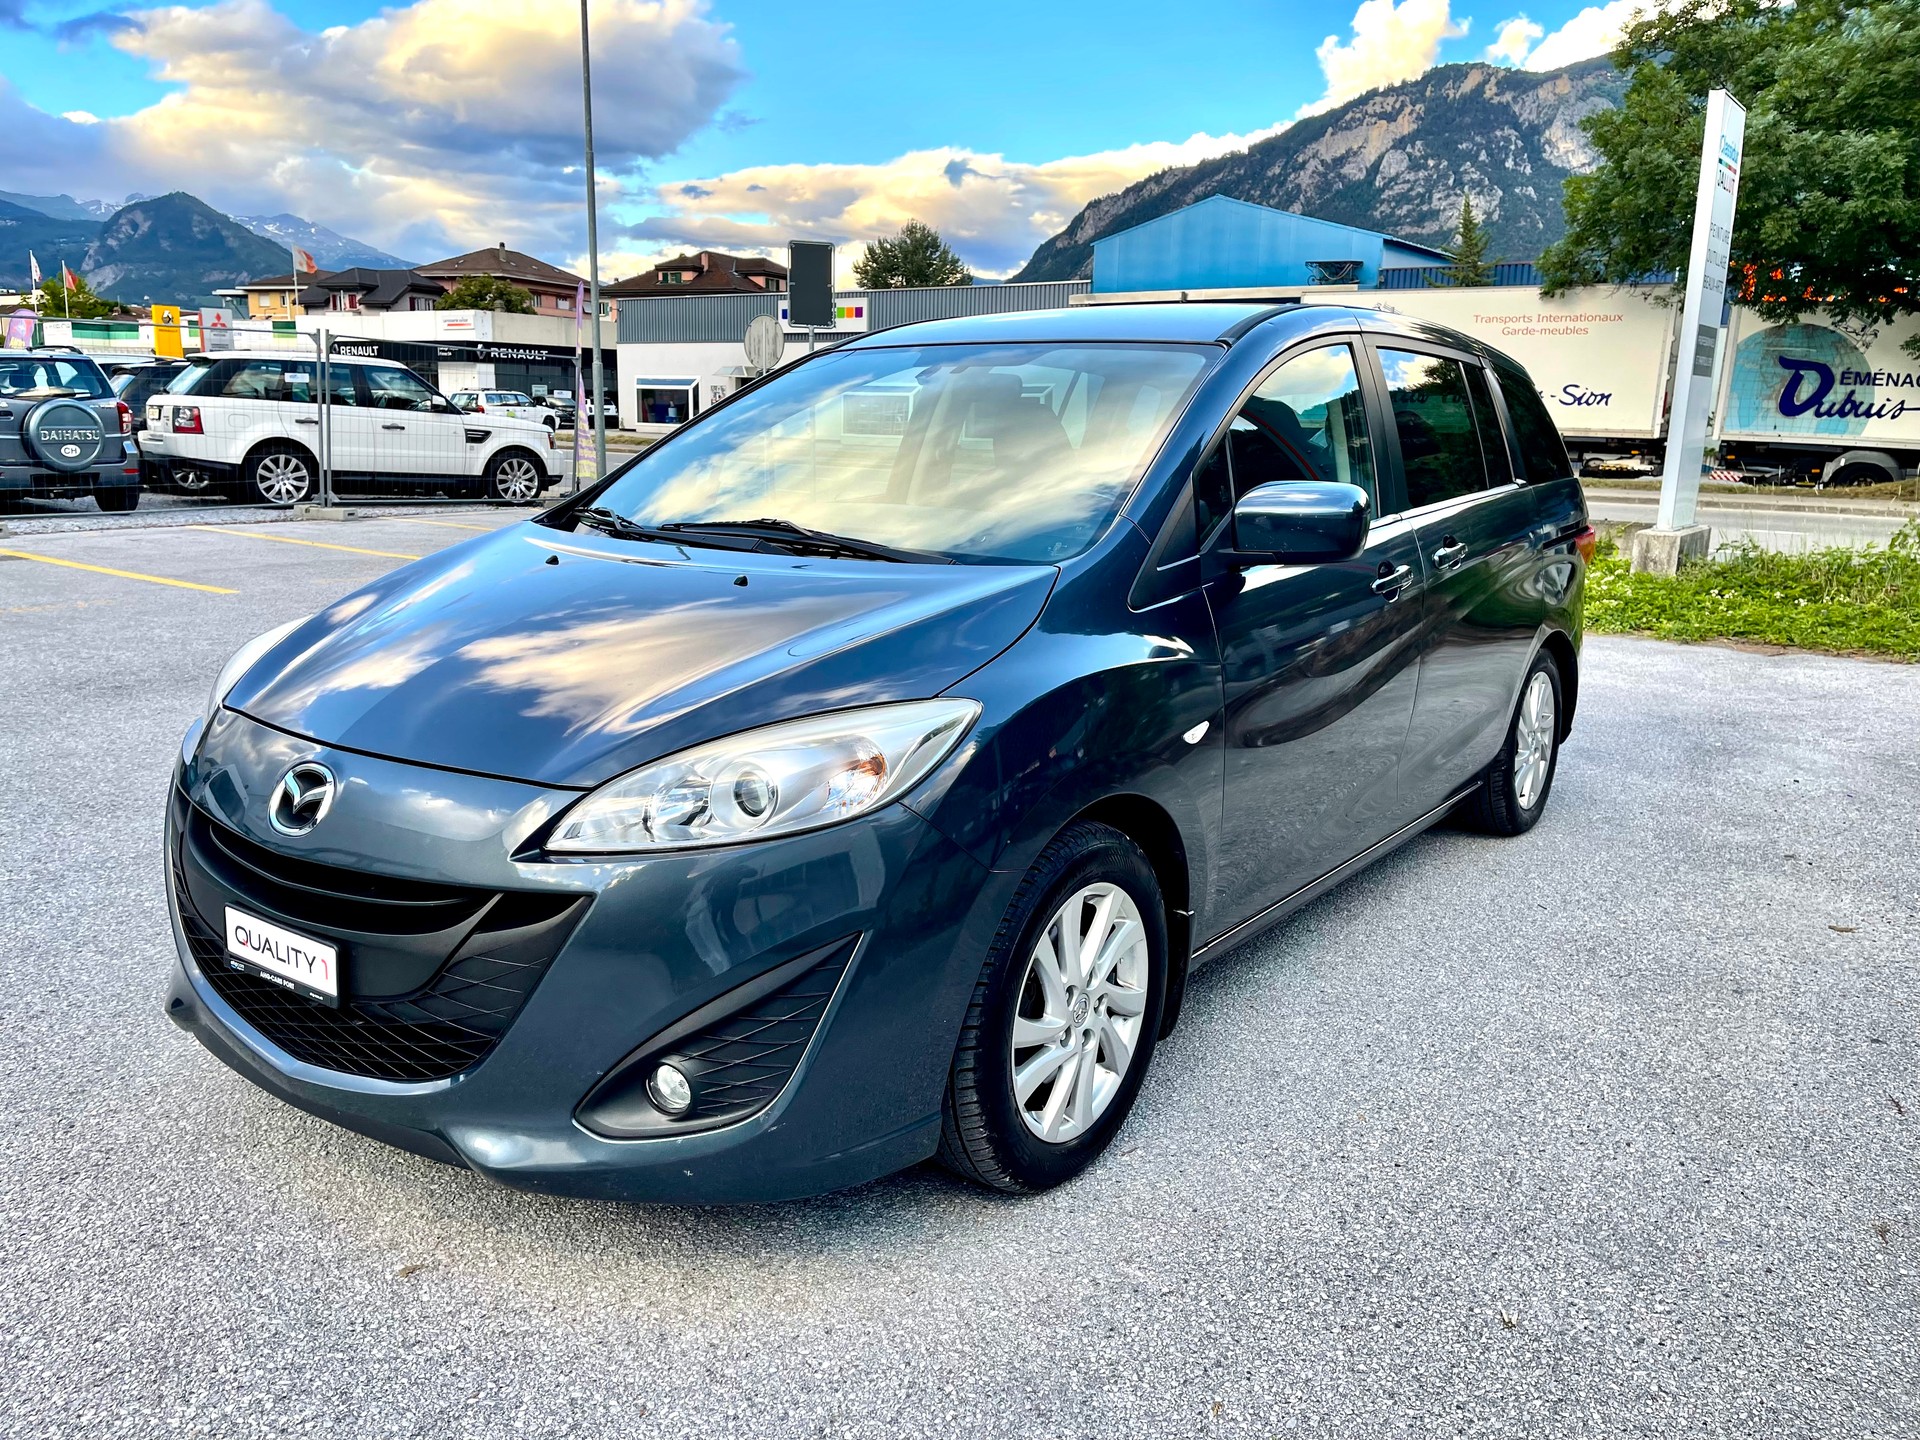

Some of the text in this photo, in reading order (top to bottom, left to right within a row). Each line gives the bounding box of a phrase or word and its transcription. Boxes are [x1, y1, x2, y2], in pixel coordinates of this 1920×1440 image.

[1473, 312, 1624, 324] Transports Internationaux
[1501, 325, 1589, 336] Garde-meubles
[340, 345, 379, 357] RENAULT
[490, 347, 549, 361] RENAULT
[1558, 384, 1613, 406] Sion
[40, 430, 100, 442] DAIHATSU
[63, 446, 78, 455] CH
